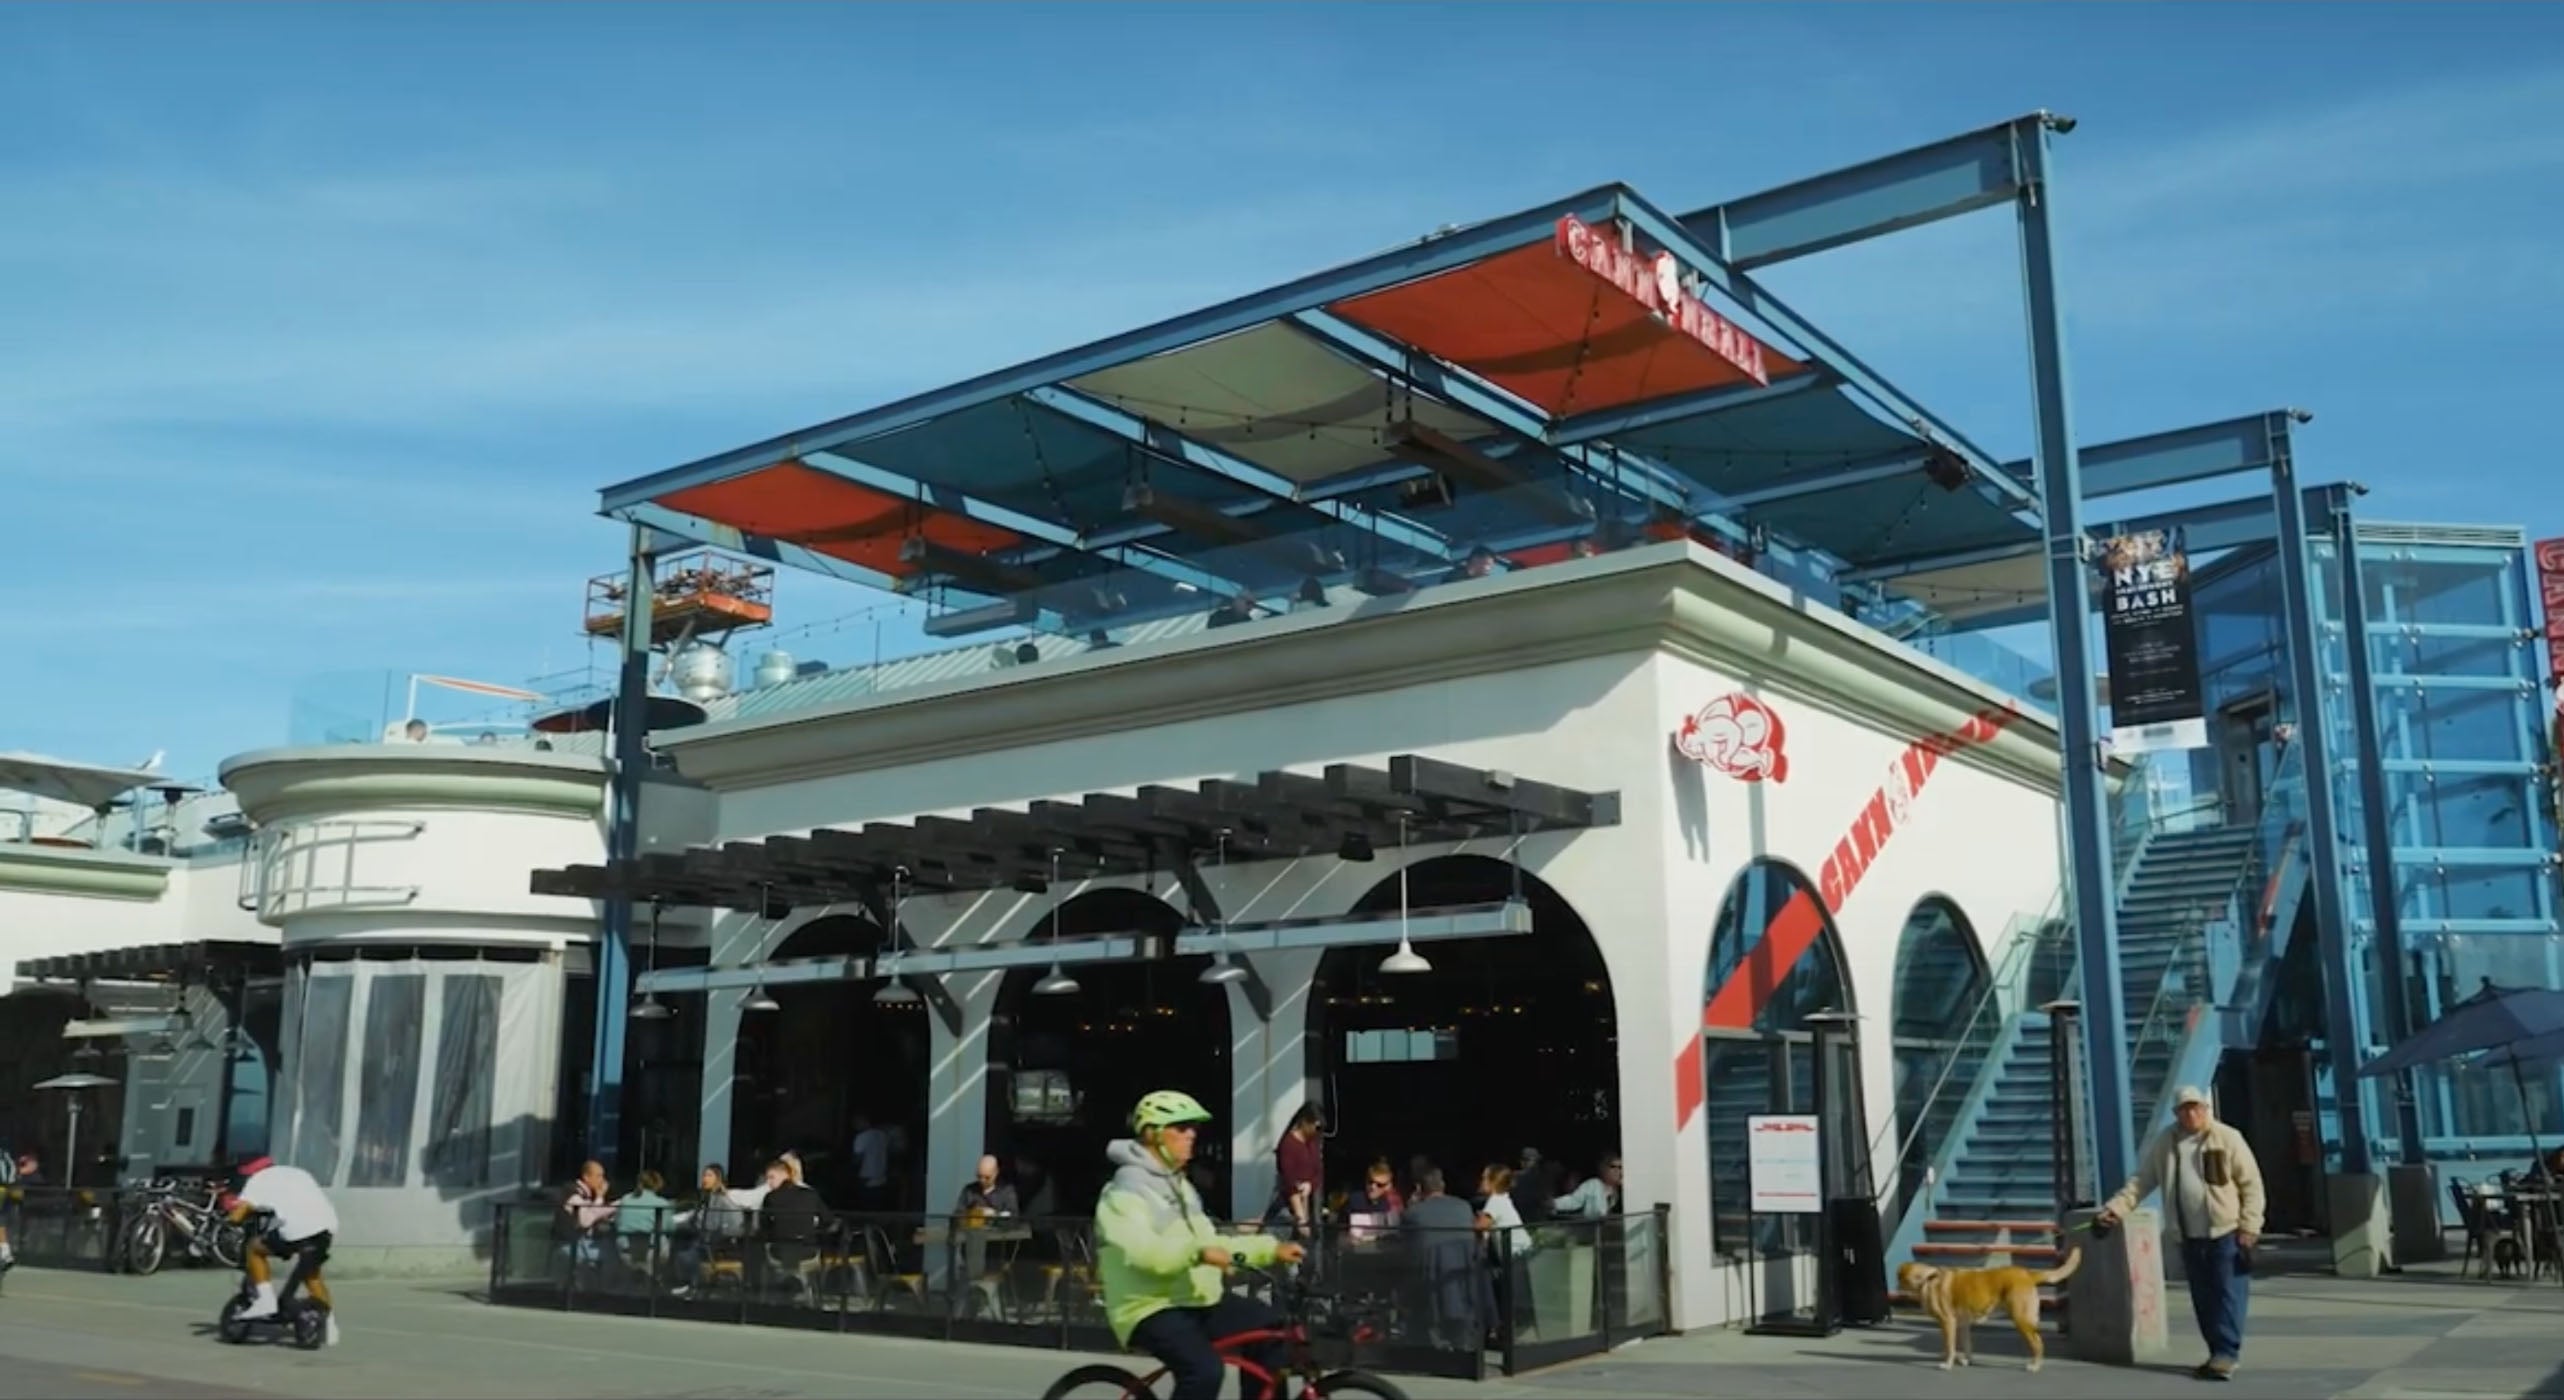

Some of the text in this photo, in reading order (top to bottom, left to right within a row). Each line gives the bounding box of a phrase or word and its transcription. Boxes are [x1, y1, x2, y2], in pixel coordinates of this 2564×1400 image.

[1561, 212, 1769, 387] CANNNBALL
[2114, 560, 2178, 587] NYE
[2116, 588, 2176, 612] BASH
